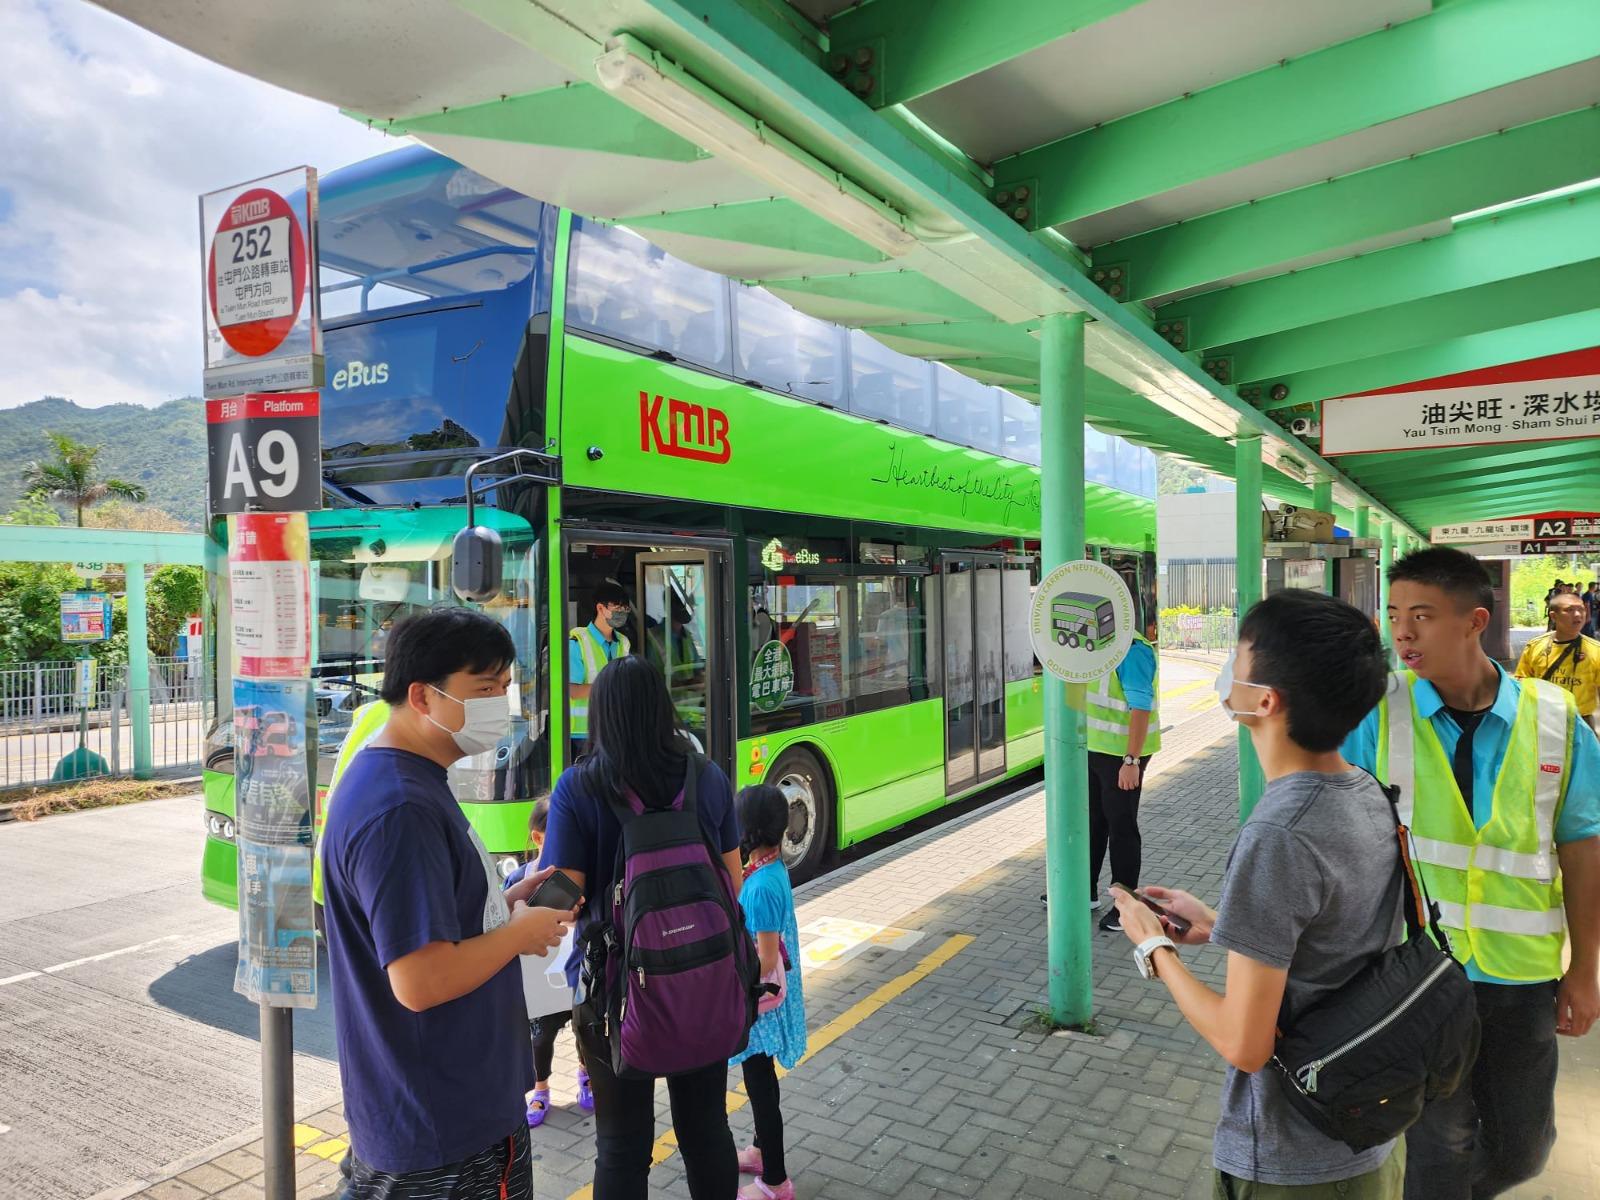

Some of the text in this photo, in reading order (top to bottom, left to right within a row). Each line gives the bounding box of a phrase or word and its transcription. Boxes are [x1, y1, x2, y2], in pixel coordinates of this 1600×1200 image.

[232, 225, 272, 264] 252
[235, 282, 272, 300] 屯門方向
[332, 361, 389, 391] eBus
[220, 400, 304, 418] 月台 Platform
[639, 390, 732, 465] KMB
[1403, 428, 1426, 438] Yau
[1430, 426, 1460, 436] Tsim
[1465, 423, 1501, 434] Mong
[1512, 419, 1551, 430] Sham
[1556, 415, 1587, 427] Shui
[223, 429, 300, 499] A9
[871, 441, 955, 491] Heartbeat
[954, 470, 973, 517] of
[1538, 521, 1566, 536] A2
[795, 548, 820, 564] eBus
[1523, 543, 1541, 553] A1
[1033, 563, 1129, 634] DRIVING CARBON NEUTRALITY FORWARD
[763, 648, 782, 664] 全港
[752, 676, 790, 698] 電巴車隊
